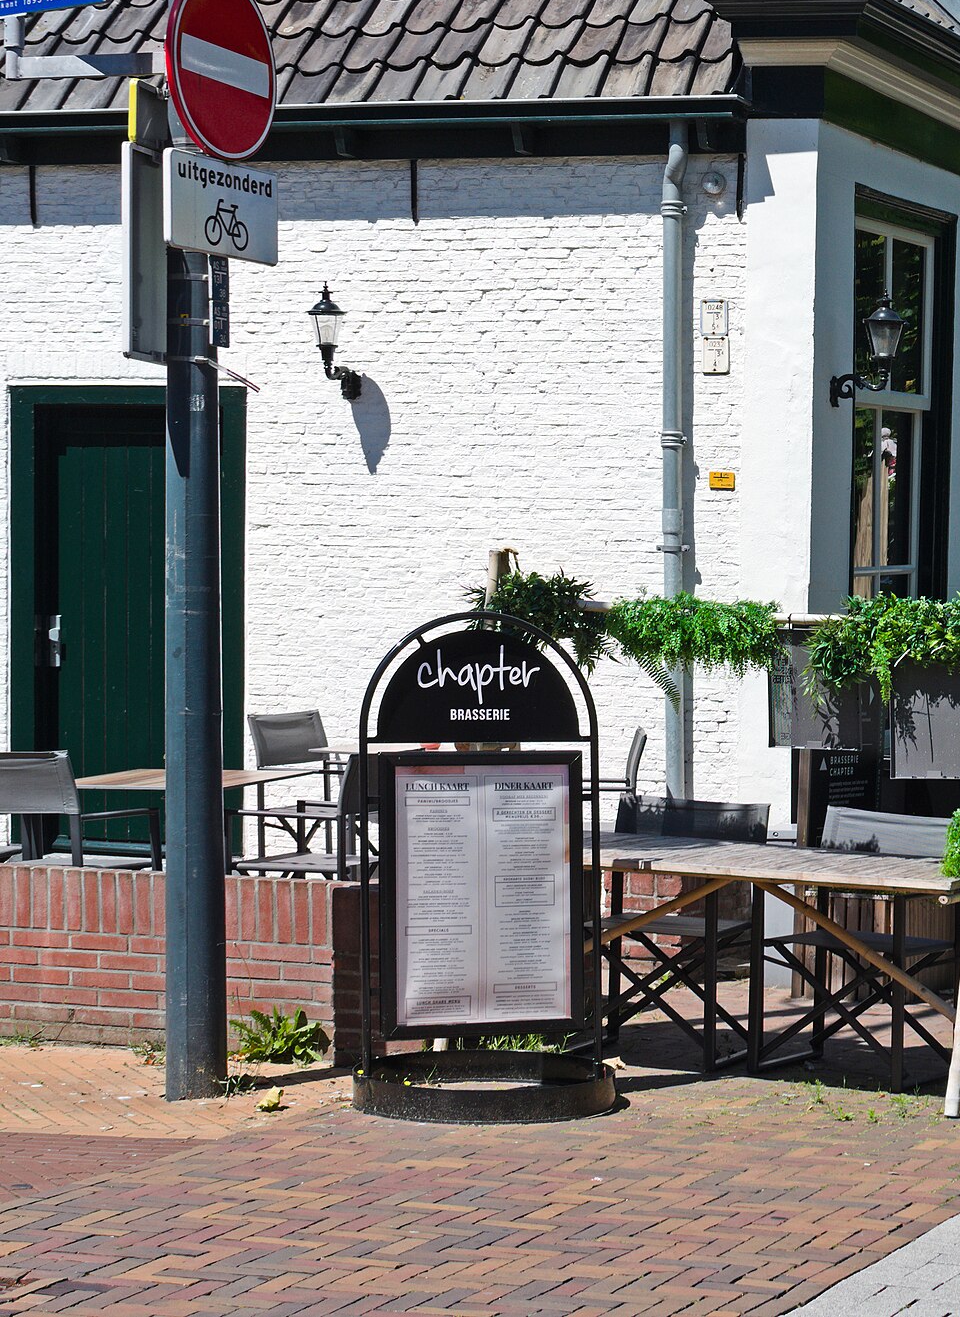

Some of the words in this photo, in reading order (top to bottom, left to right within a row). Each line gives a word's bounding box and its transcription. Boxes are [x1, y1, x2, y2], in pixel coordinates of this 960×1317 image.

[177, 160, 272, 198] uitgezonderd
[417, 644, 540, 705] chapter
[450, 708, 511, 721] BRASSERIE
[830, 755, 859, 765] BRASSERIE
[829, 767, 854, 777] CHAPTER
[405, 782, 437, 792] LUNCH
[439, 782, 470, 792] KAART
[494, 782, 522, 792] DINER
[524, 781, 554, 791] KAART
